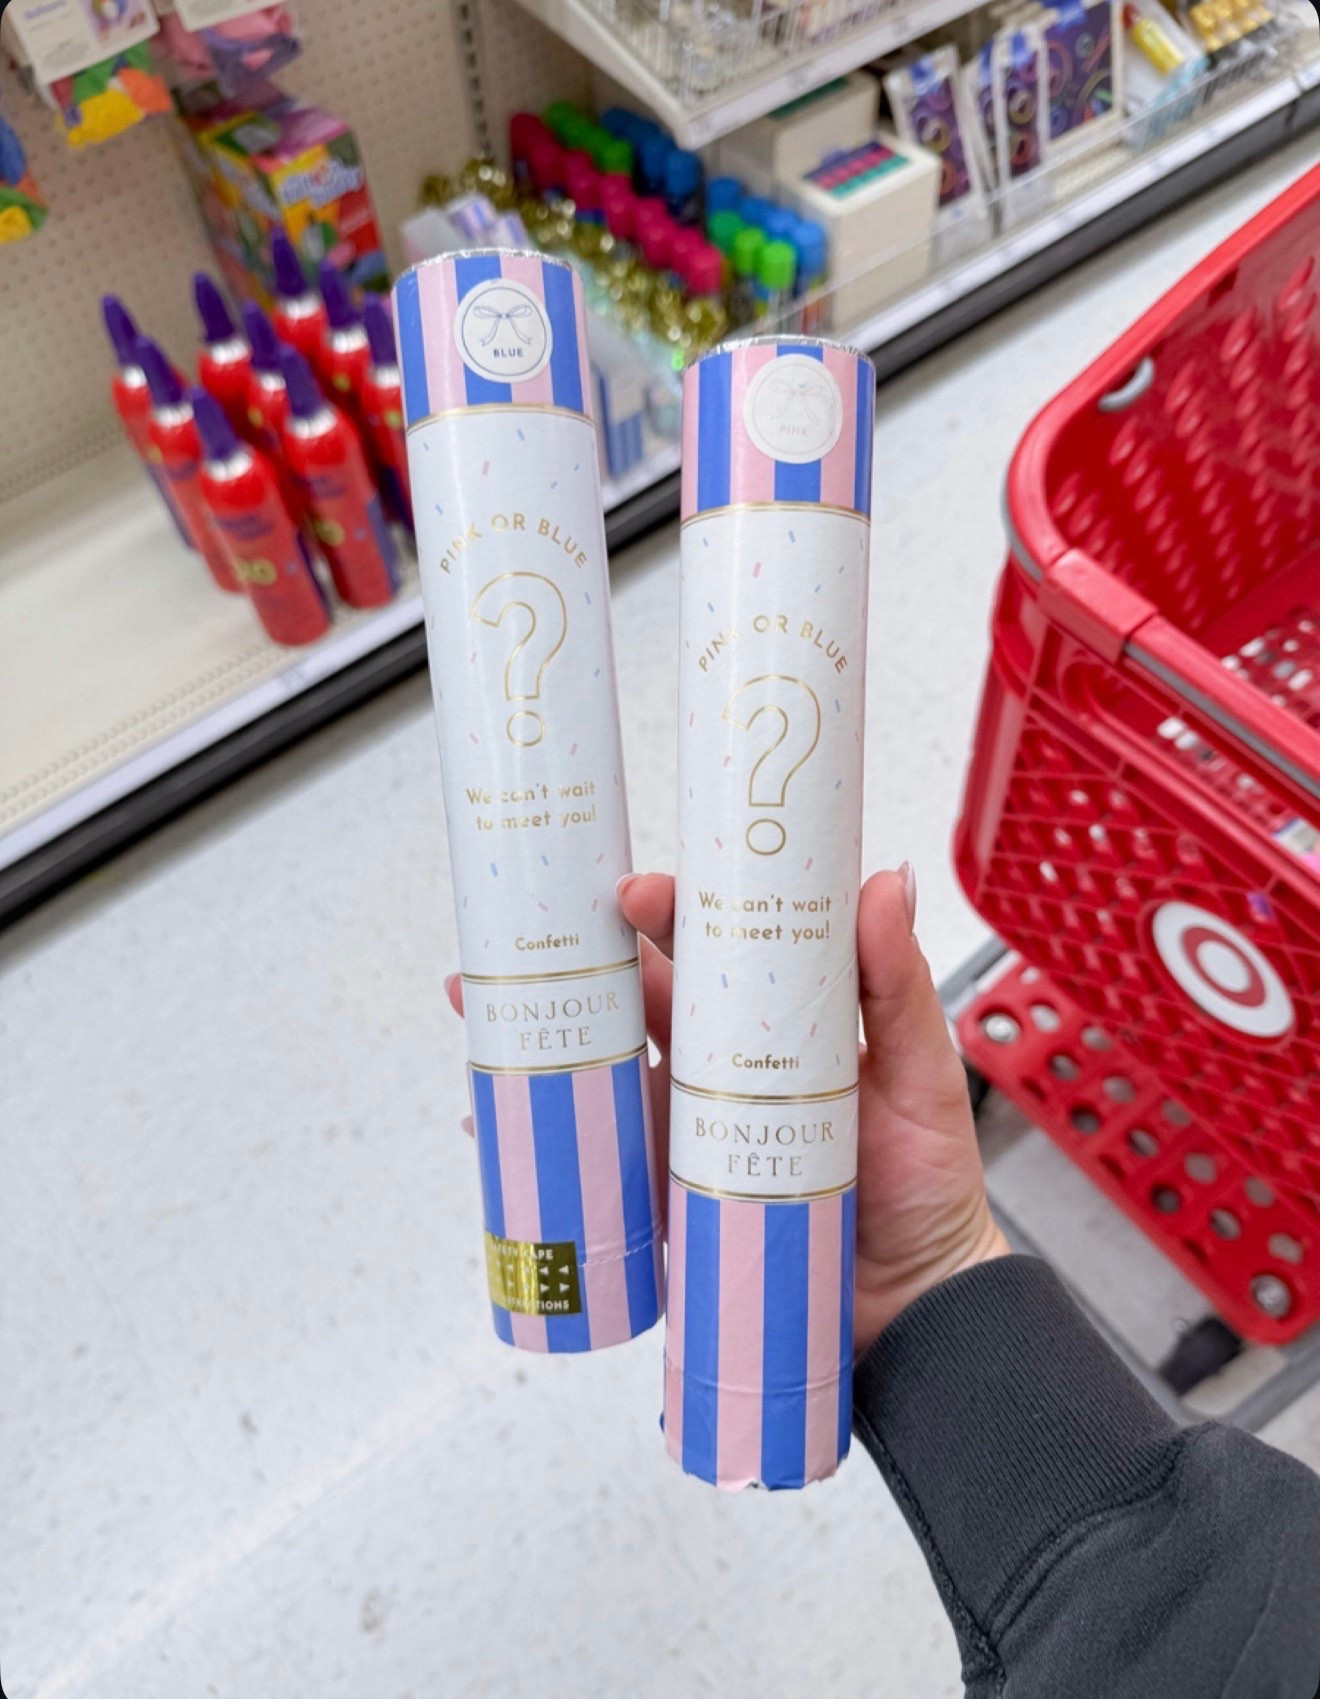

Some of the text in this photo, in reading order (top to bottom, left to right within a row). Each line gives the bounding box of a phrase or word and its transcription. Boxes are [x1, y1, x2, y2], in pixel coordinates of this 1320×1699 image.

[493, 347, 523, 357] BLUE
[779, 424, 808, 436] PINK
[440, 513, 588, 574] PINK OR BLUE
[753, 614, 789, 634] OR
[800, 620, 848, 674] BLUE
[466, 780, 596, 805] We can't wait
[476, 804, 597, 830] to meet you!
[698, 891, 832, 912] We can't wait
[515, 933, 580, 951] Confetti
[705, 920, 830, 944] to meet you!
[486, 991, 620, 1022] BONJOUR
[520, 1026, 592, 1050] FÊTE
[732, 1053, 800, 1070] Confetti
[695, 1117, 834, 1145] BONJOUR
[728, 1152, 803, 1176] FÊTE
